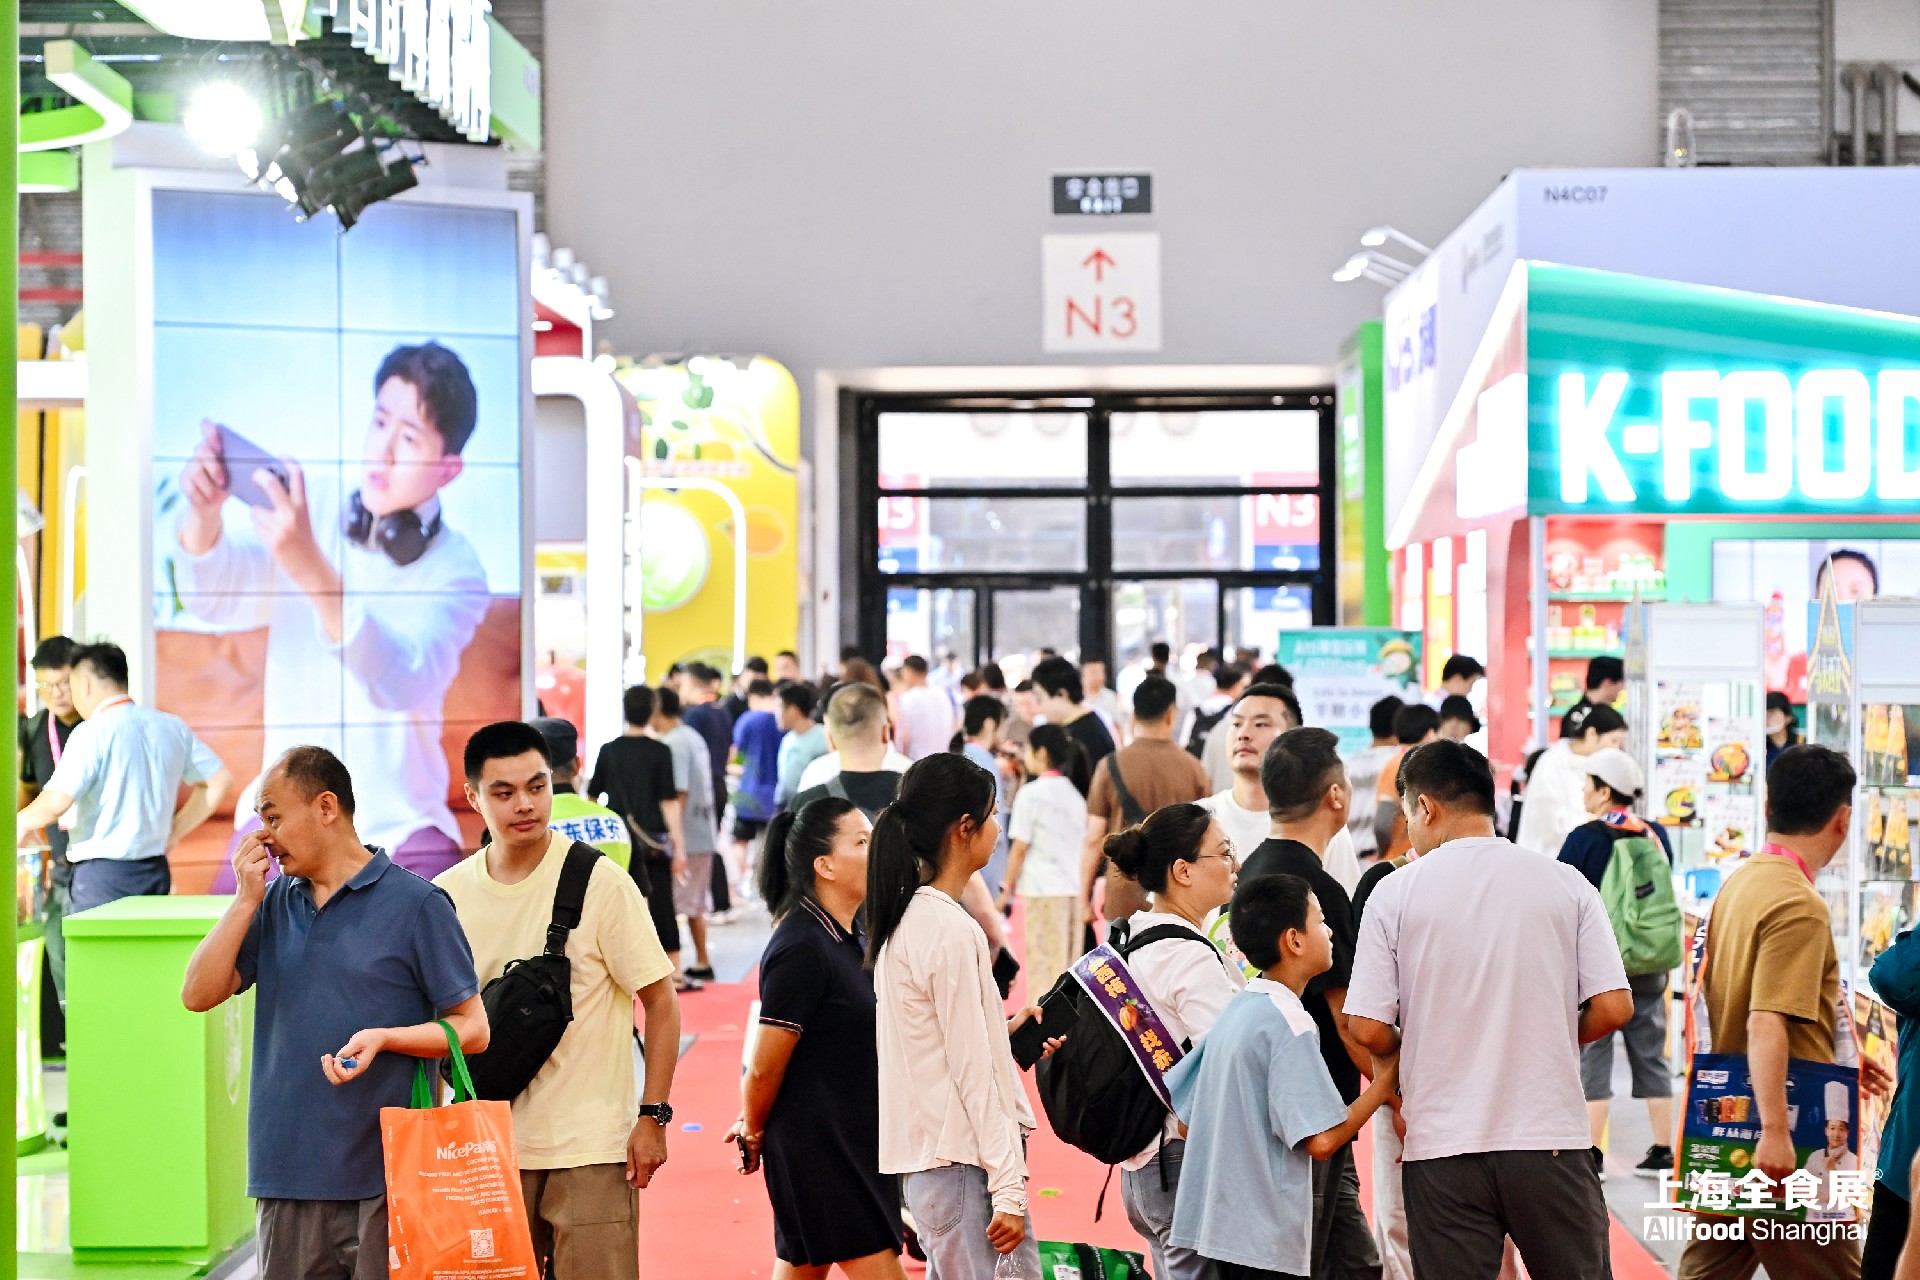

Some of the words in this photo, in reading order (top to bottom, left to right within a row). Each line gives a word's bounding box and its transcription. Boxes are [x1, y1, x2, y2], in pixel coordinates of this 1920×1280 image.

[1544, 186, 1608, 204] N4C07
[1065, 297, 1138, 338] N3
[1255, 494, 1315, 527] N3
